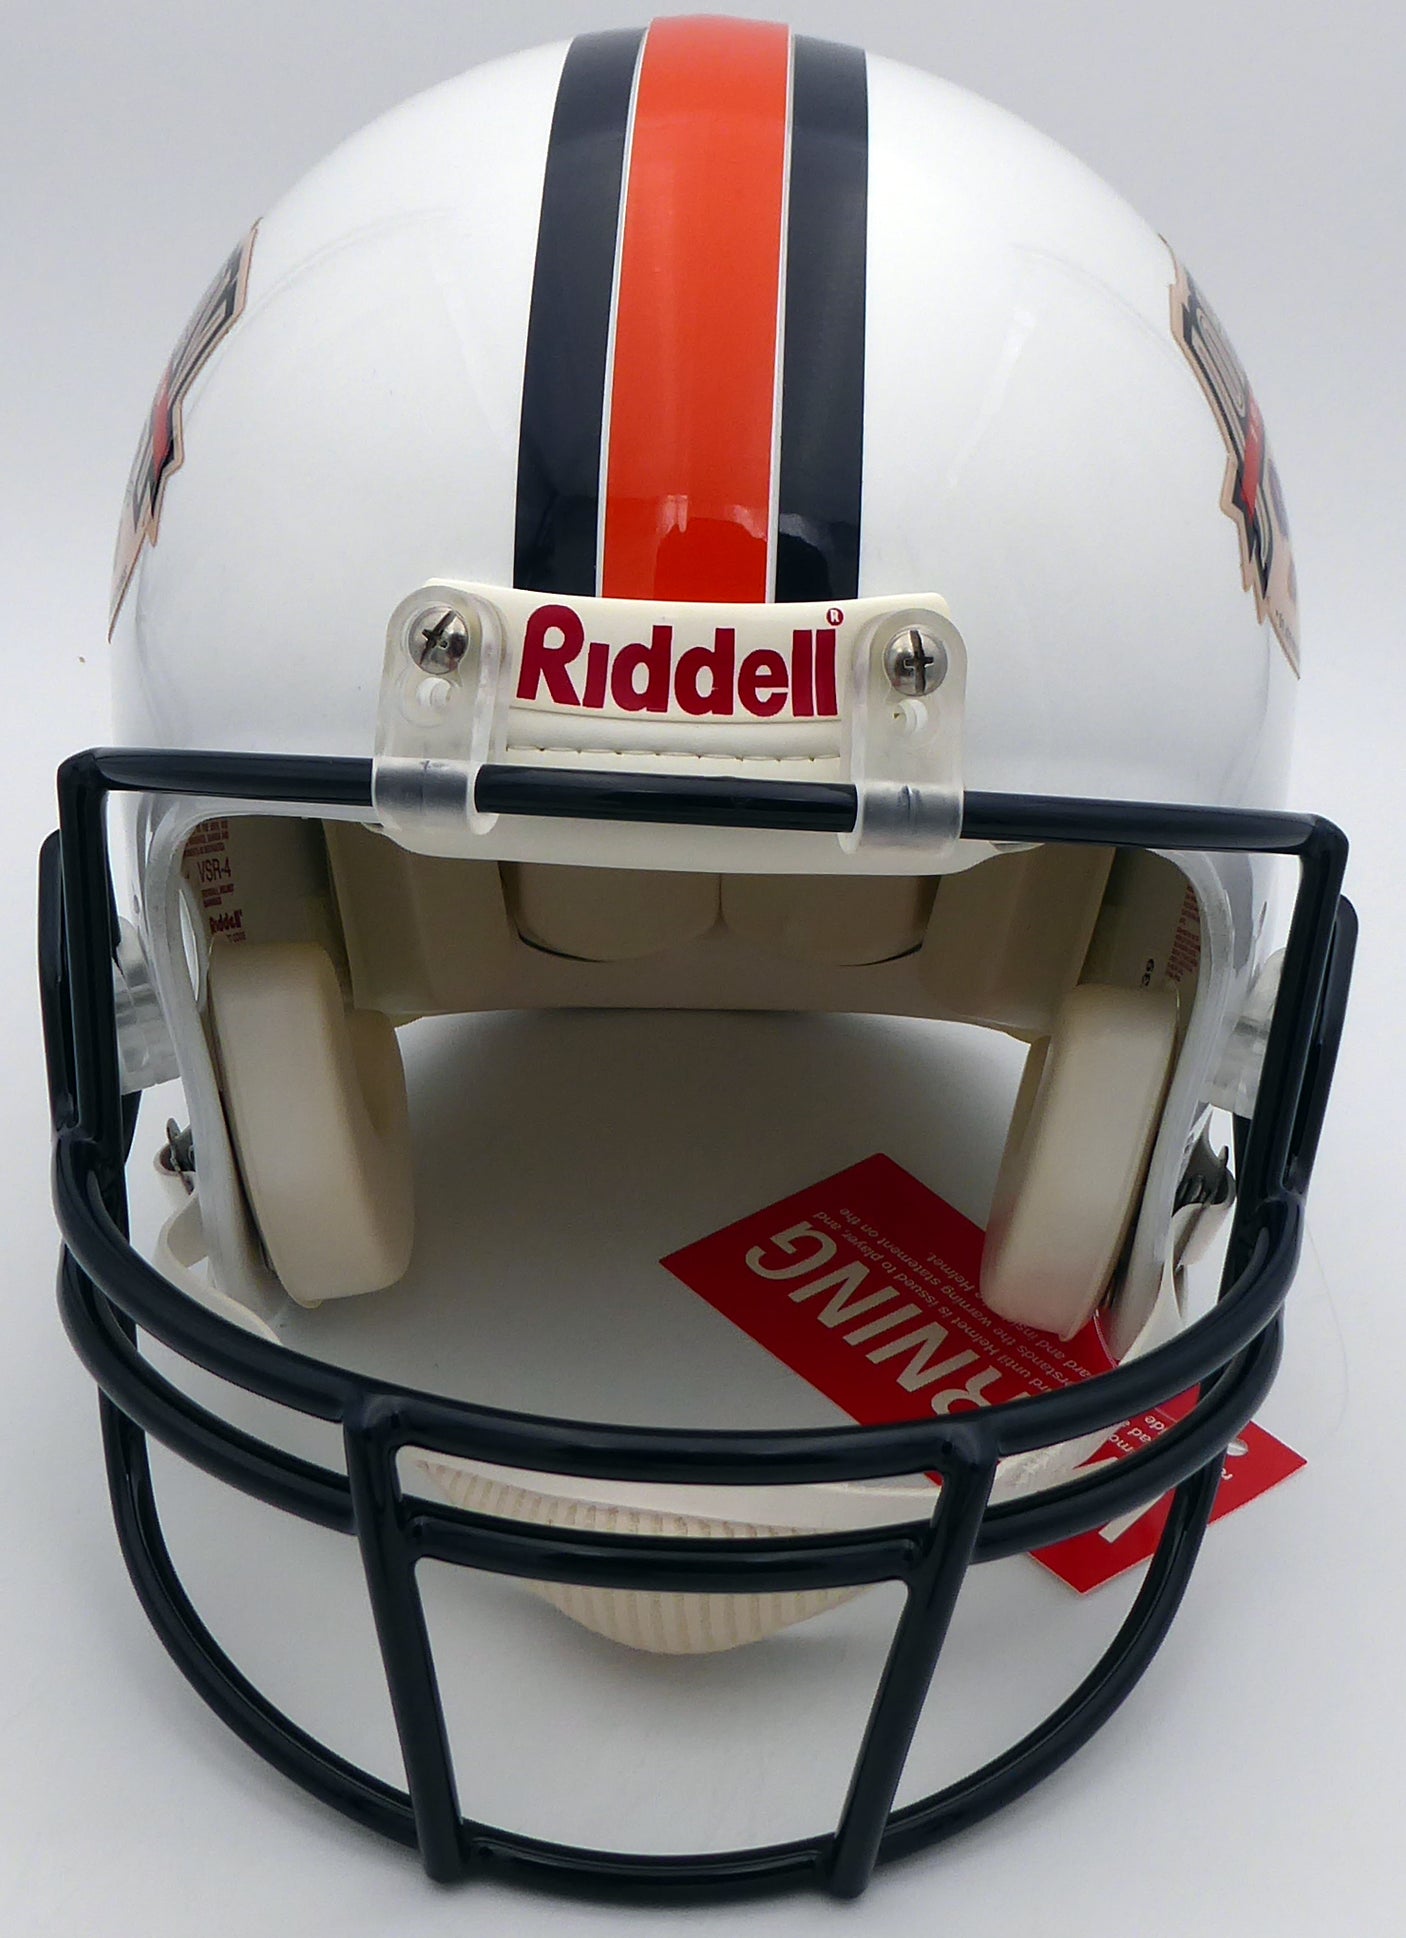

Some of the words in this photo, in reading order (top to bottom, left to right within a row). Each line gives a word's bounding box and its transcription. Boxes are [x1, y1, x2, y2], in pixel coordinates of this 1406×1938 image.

[516, 604, 839, 718] Riddell
[197, 856, 232, 882] VSR-4
[813, 1211, 842, 1230] and
[837, 1208, 861, 1223] the
[860, 1223, 879, 1236] on
[840, 1231, 884, 1261] player,
[876, 1238, 941, 1285] statement
[879, 1261, 897, 1272] to
[925, 1253, 976, 1291] Helmet.
[892, 1272, 939, 1306] issued
[937, 1307, 953, 1316] is
[938, 1285, 992, 1325] warning
[949, 1317, 1000, 1354] Helmet
[991, 1327, 1016, 1344] the
[1036, 1339, 1066, 1359] and
[997, 1354, 1032, 1377] until
[1062, 1359, 1092, 1379] ard
[1028, 1378, 1052, 1394] rd
[1141, 1416, 1168, 1433] ide
[1126, 1428, 1152, 1444] ad
